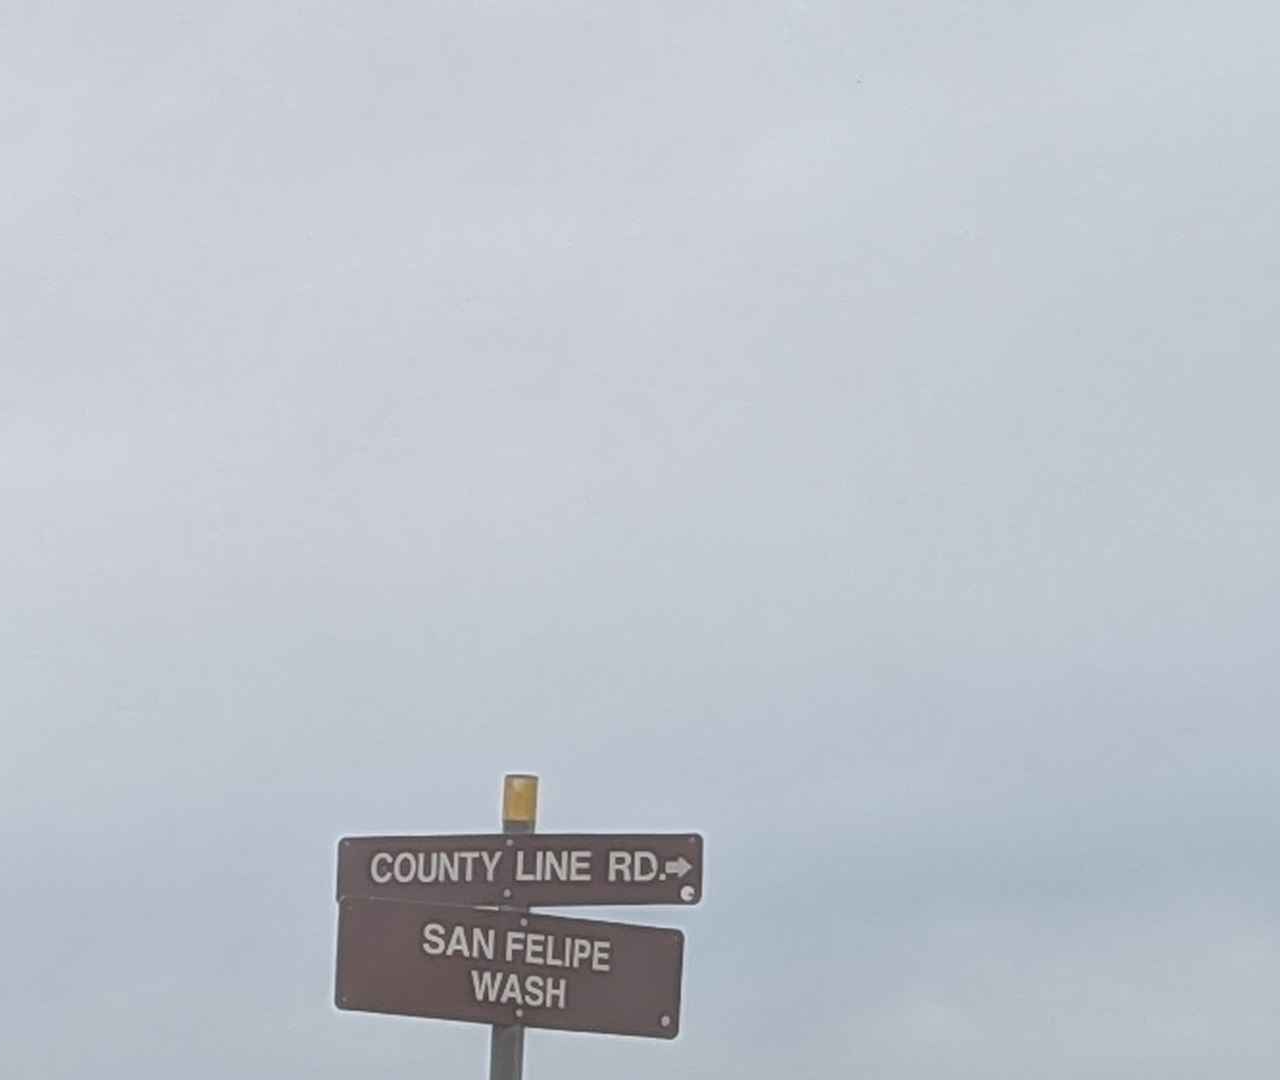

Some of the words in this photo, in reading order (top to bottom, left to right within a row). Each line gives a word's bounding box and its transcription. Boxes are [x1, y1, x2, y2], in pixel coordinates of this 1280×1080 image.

[370, 852, 502, 883] COUNTY
[515, 851, 591, 882] LINE
[608, 851, 667, 882] RD.
[422, 923, 495, 960] SAN
[505, 931, 611, 971] FELIPE
[471, 970, 566, 1008] WASH
